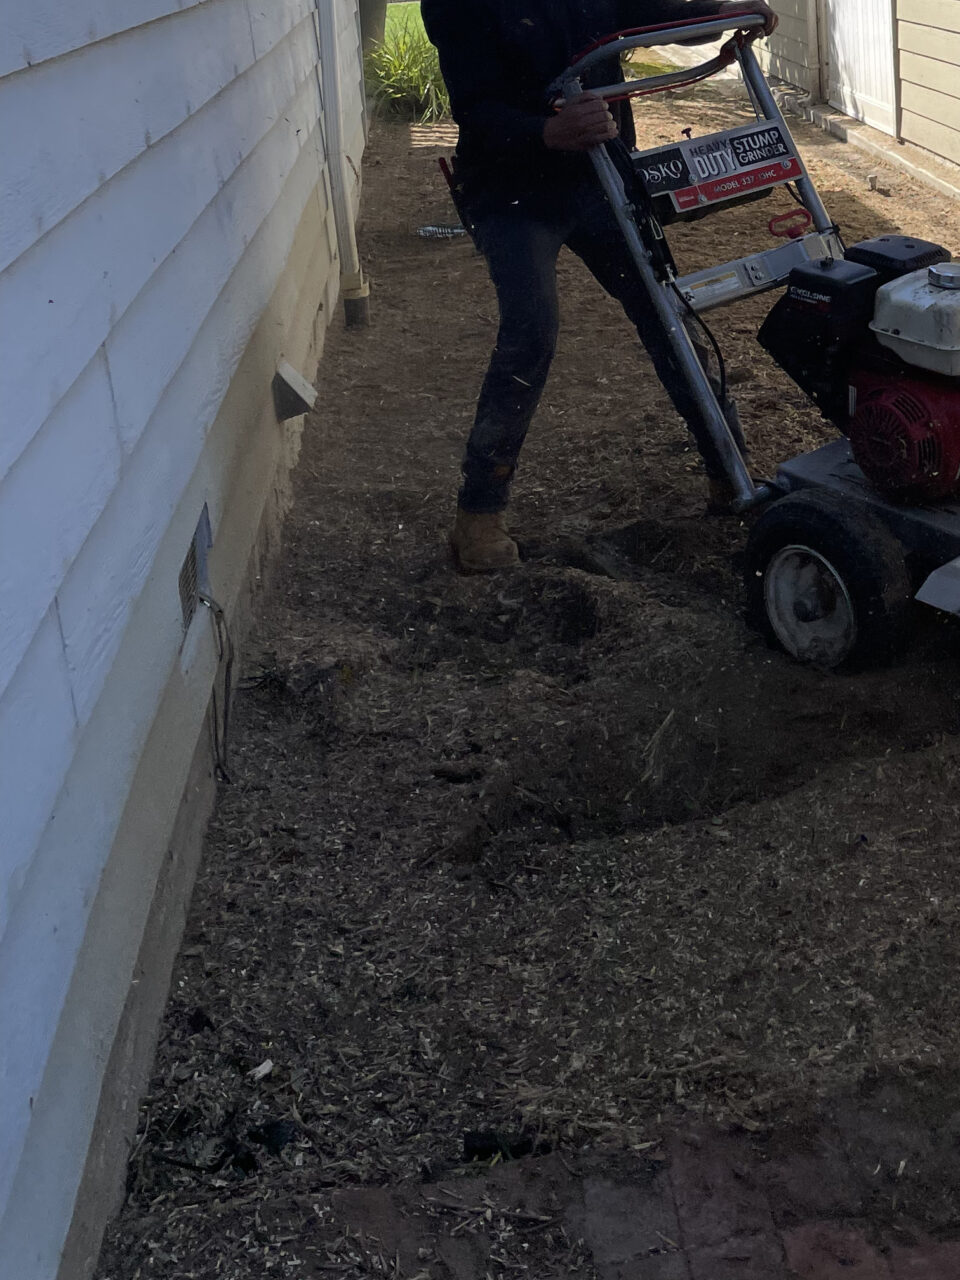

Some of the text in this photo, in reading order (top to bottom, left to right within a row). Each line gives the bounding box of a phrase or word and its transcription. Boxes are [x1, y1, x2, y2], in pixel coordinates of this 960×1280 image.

[733, 130, 779, 152] STUMP
[694, 148, 736, 178] DUTY
[738, 143, 787, 164] GRINDER
[714, 180, 740, 192] MODEL
